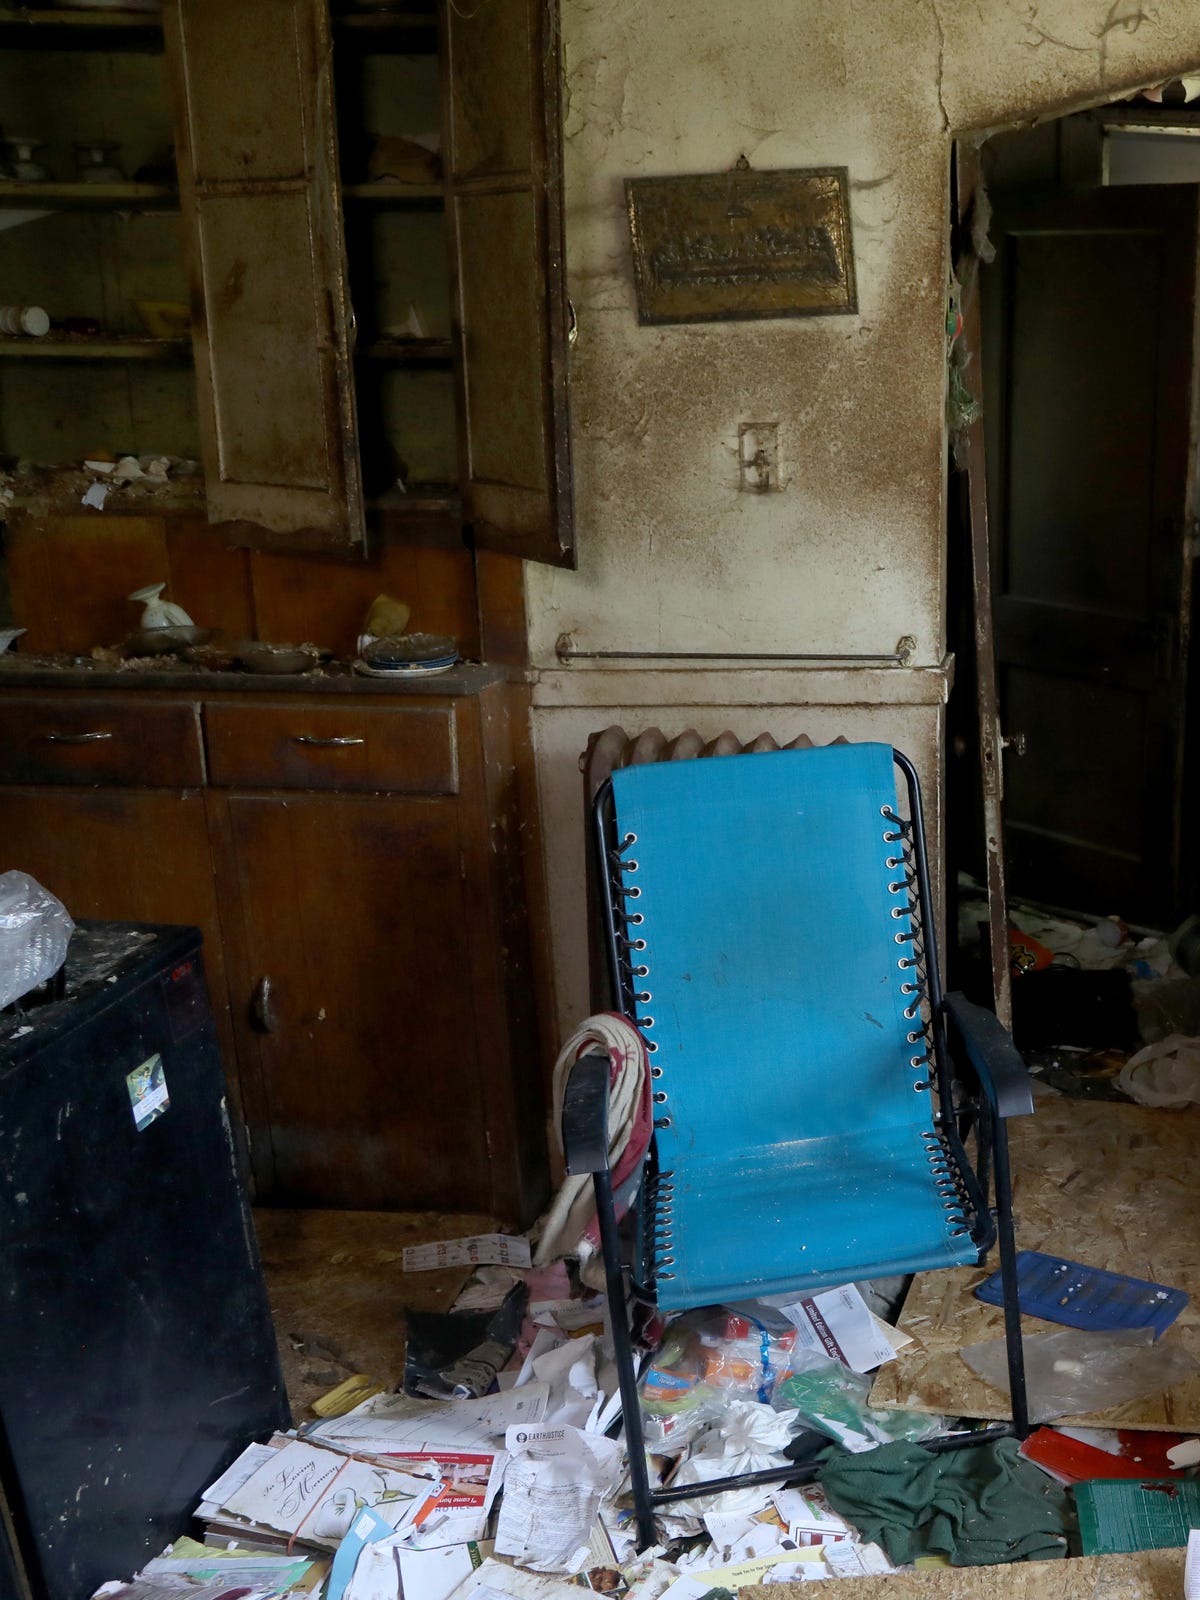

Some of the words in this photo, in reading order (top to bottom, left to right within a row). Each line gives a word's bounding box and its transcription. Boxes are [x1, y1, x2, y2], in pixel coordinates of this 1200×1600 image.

[805, 1304, 819, 1322] Limited
[815, 1321, 828, 1338] Edition
[824, 1336, 834, 1348] Gift
[527, 1429, 565, 1441] EARTHJUSTICE
[263, 1484, 275, 1497] In
[275, 1461, 316, 1492] Loving
[277, 1465, 340, 1518] Memory
